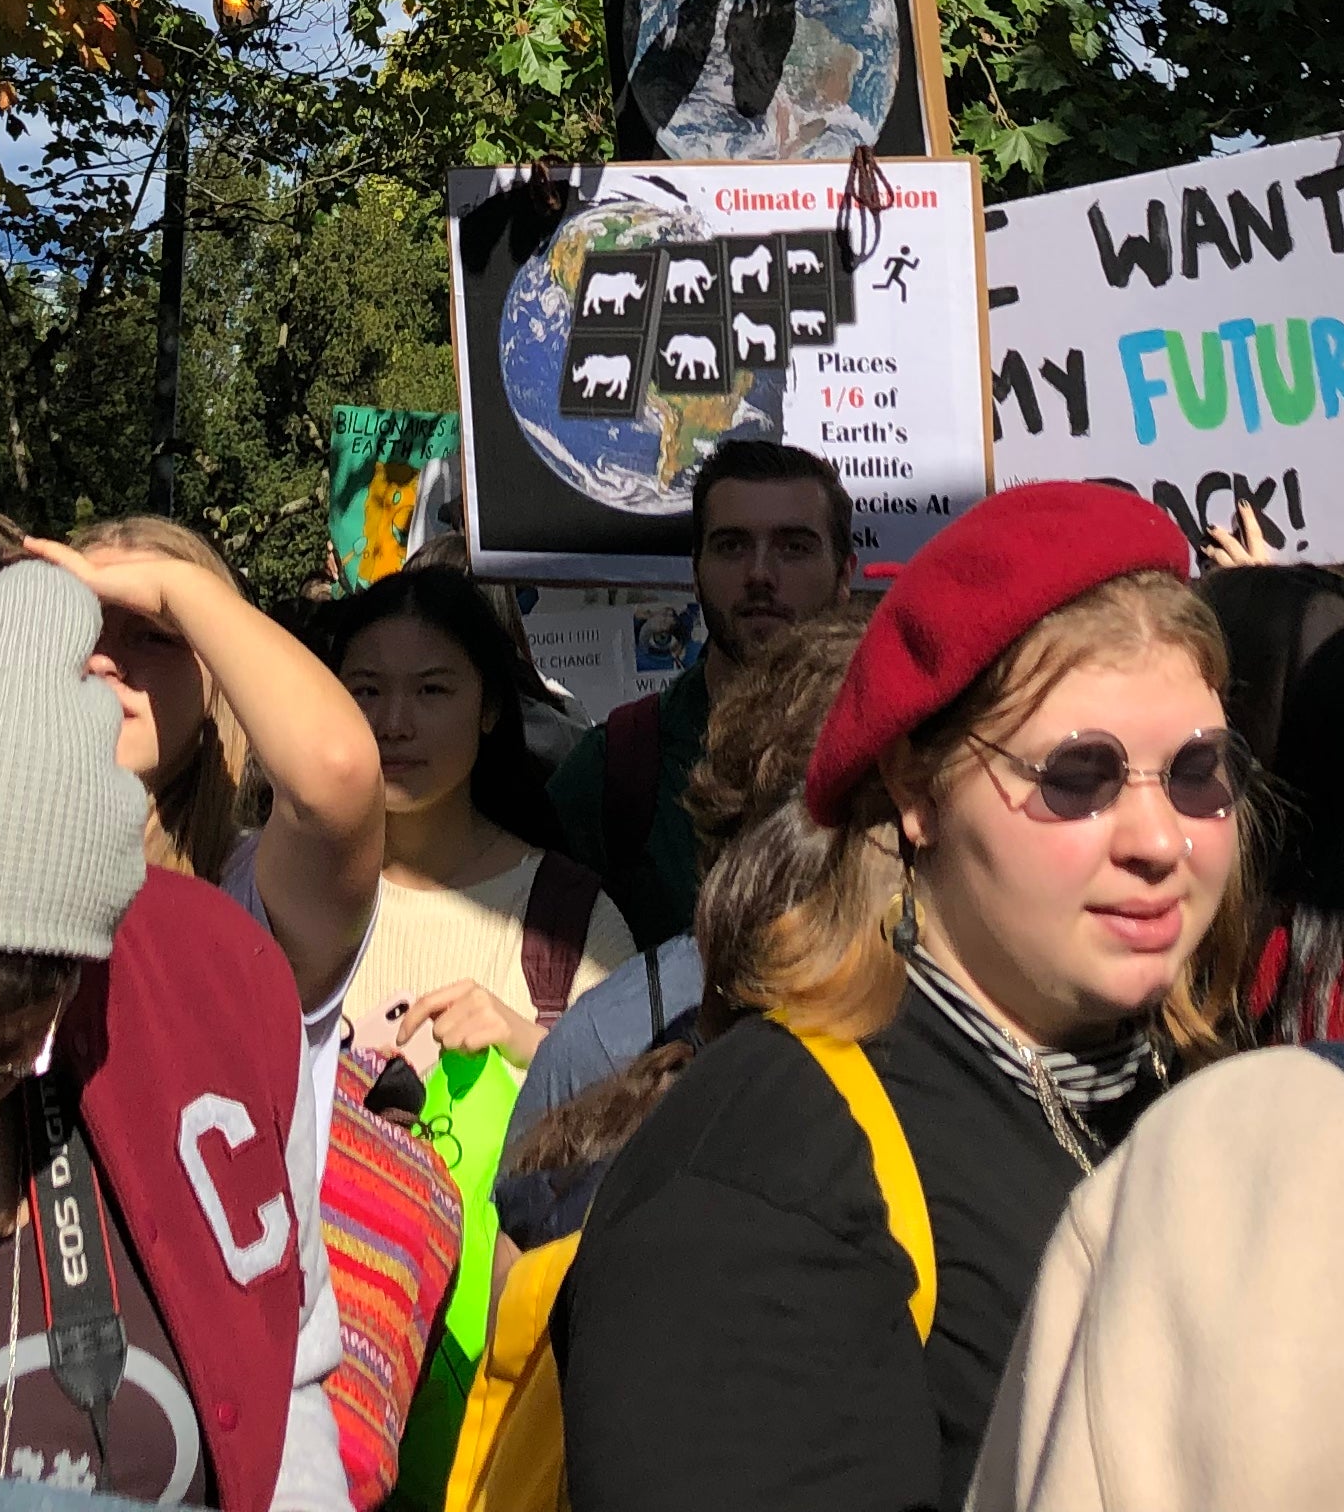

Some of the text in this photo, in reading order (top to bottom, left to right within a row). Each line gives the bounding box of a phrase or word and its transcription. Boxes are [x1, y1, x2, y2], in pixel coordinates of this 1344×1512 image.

[715, 188, 816, 211] Climate
[817, 351, 897, 373] Places
[821, 386, 899, 413] 1/6 of
[991, 348, 1090, 442] MY
[335, 411, 447, 438] BILLIONAIRES
[821, 421, 908, 443] Earth's
[352, 437, 413, 460] EARTH
[420, 443, 434, 461] IS
[855, 493, 950, 515] ecies At
[550, 653, 601, 668] CHANGE
[179, 1092, 291, 1286] C
[55, 1196, 89, 1286] EOS
